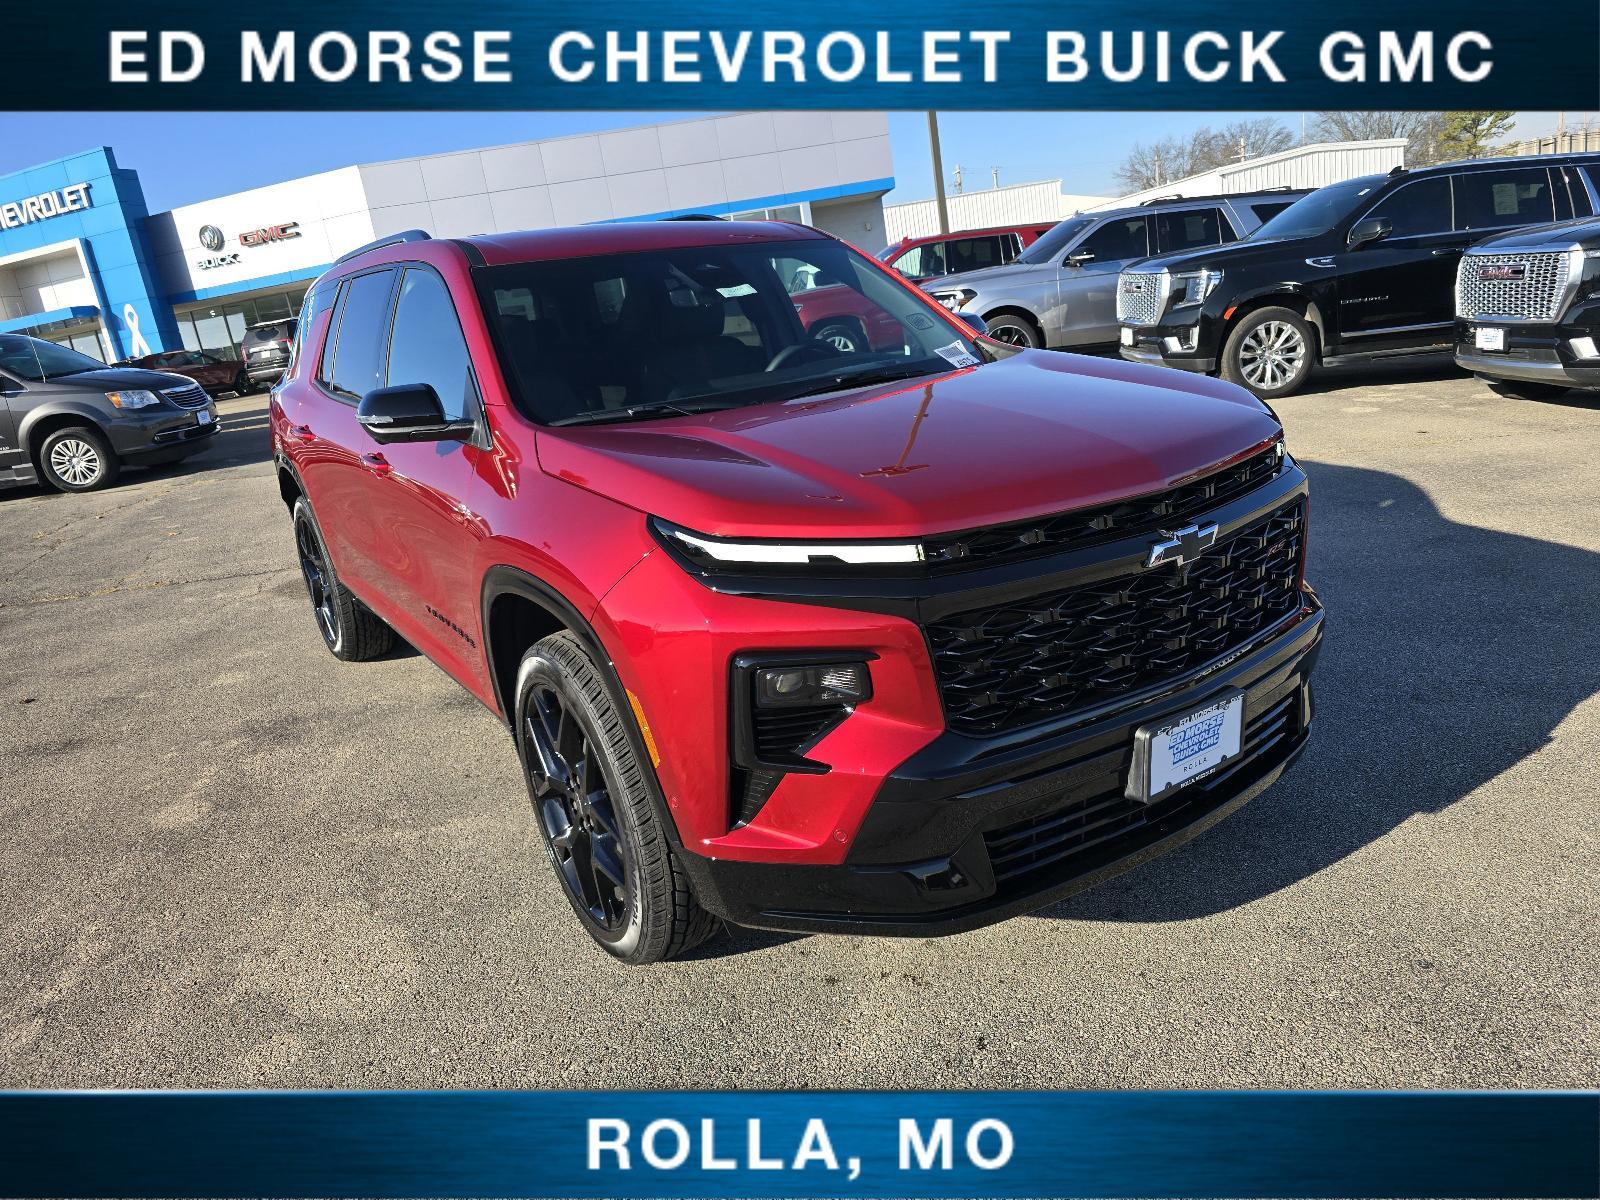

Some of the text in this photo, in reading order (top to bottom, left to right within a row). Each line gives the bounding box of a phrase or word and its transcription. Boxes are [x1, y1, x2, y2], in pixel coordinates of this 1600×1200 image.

[239, 222, 300, 247] GMC
[198, 254, 241, 270] BUICK
[1169, 713, 1224, 749] ED MORSE
[1173, 725, 1220, 753] CHEVROLET
